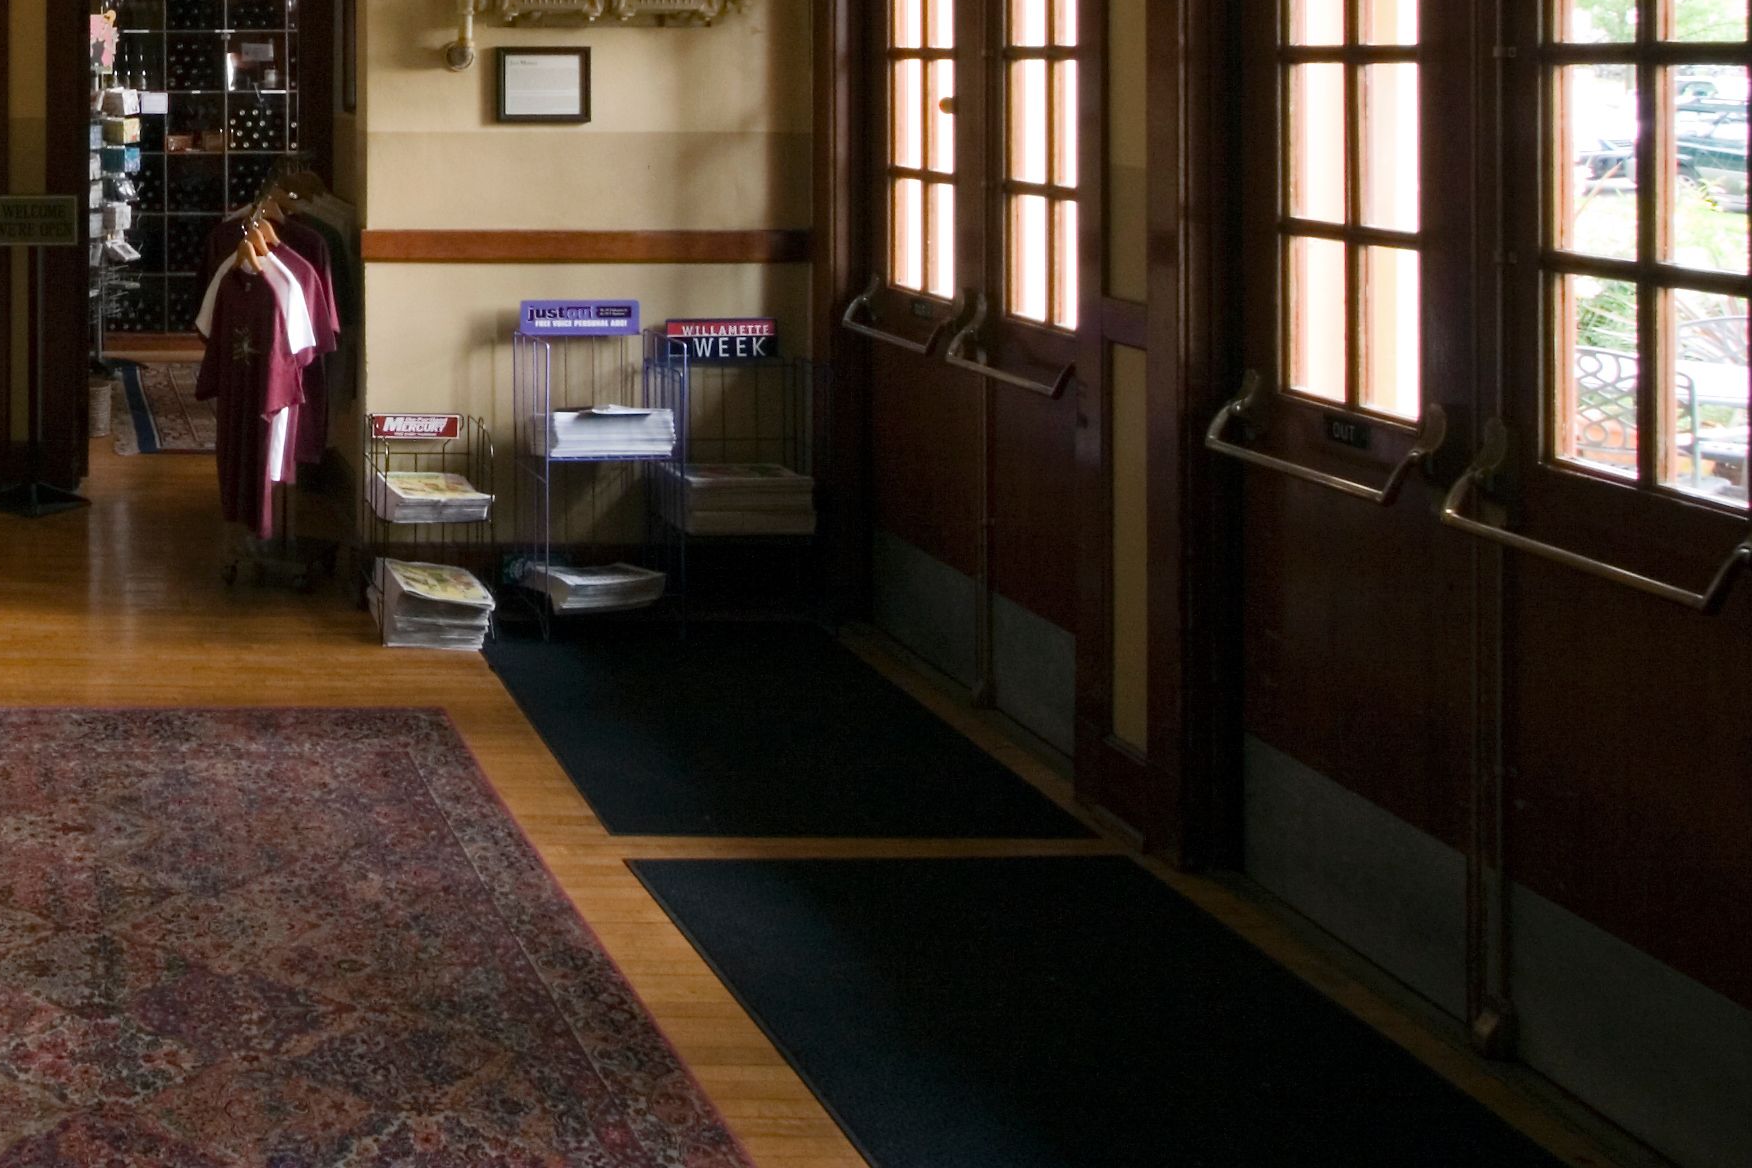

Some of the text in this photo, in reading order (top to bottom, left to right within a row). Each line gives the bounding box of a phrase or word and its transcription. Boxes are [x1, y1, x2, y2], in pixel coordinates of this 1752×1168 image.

[0, 203, 67, 218] WELCOME
[39, 222, 73, 238] OPEN
[574, 319, 609, 328] PERSONAL
[681, 324, 770, 337] WILLAMETTE
[693, 337, 767, 358] WEEK
[1332, 421, 1356, 441] OUT
